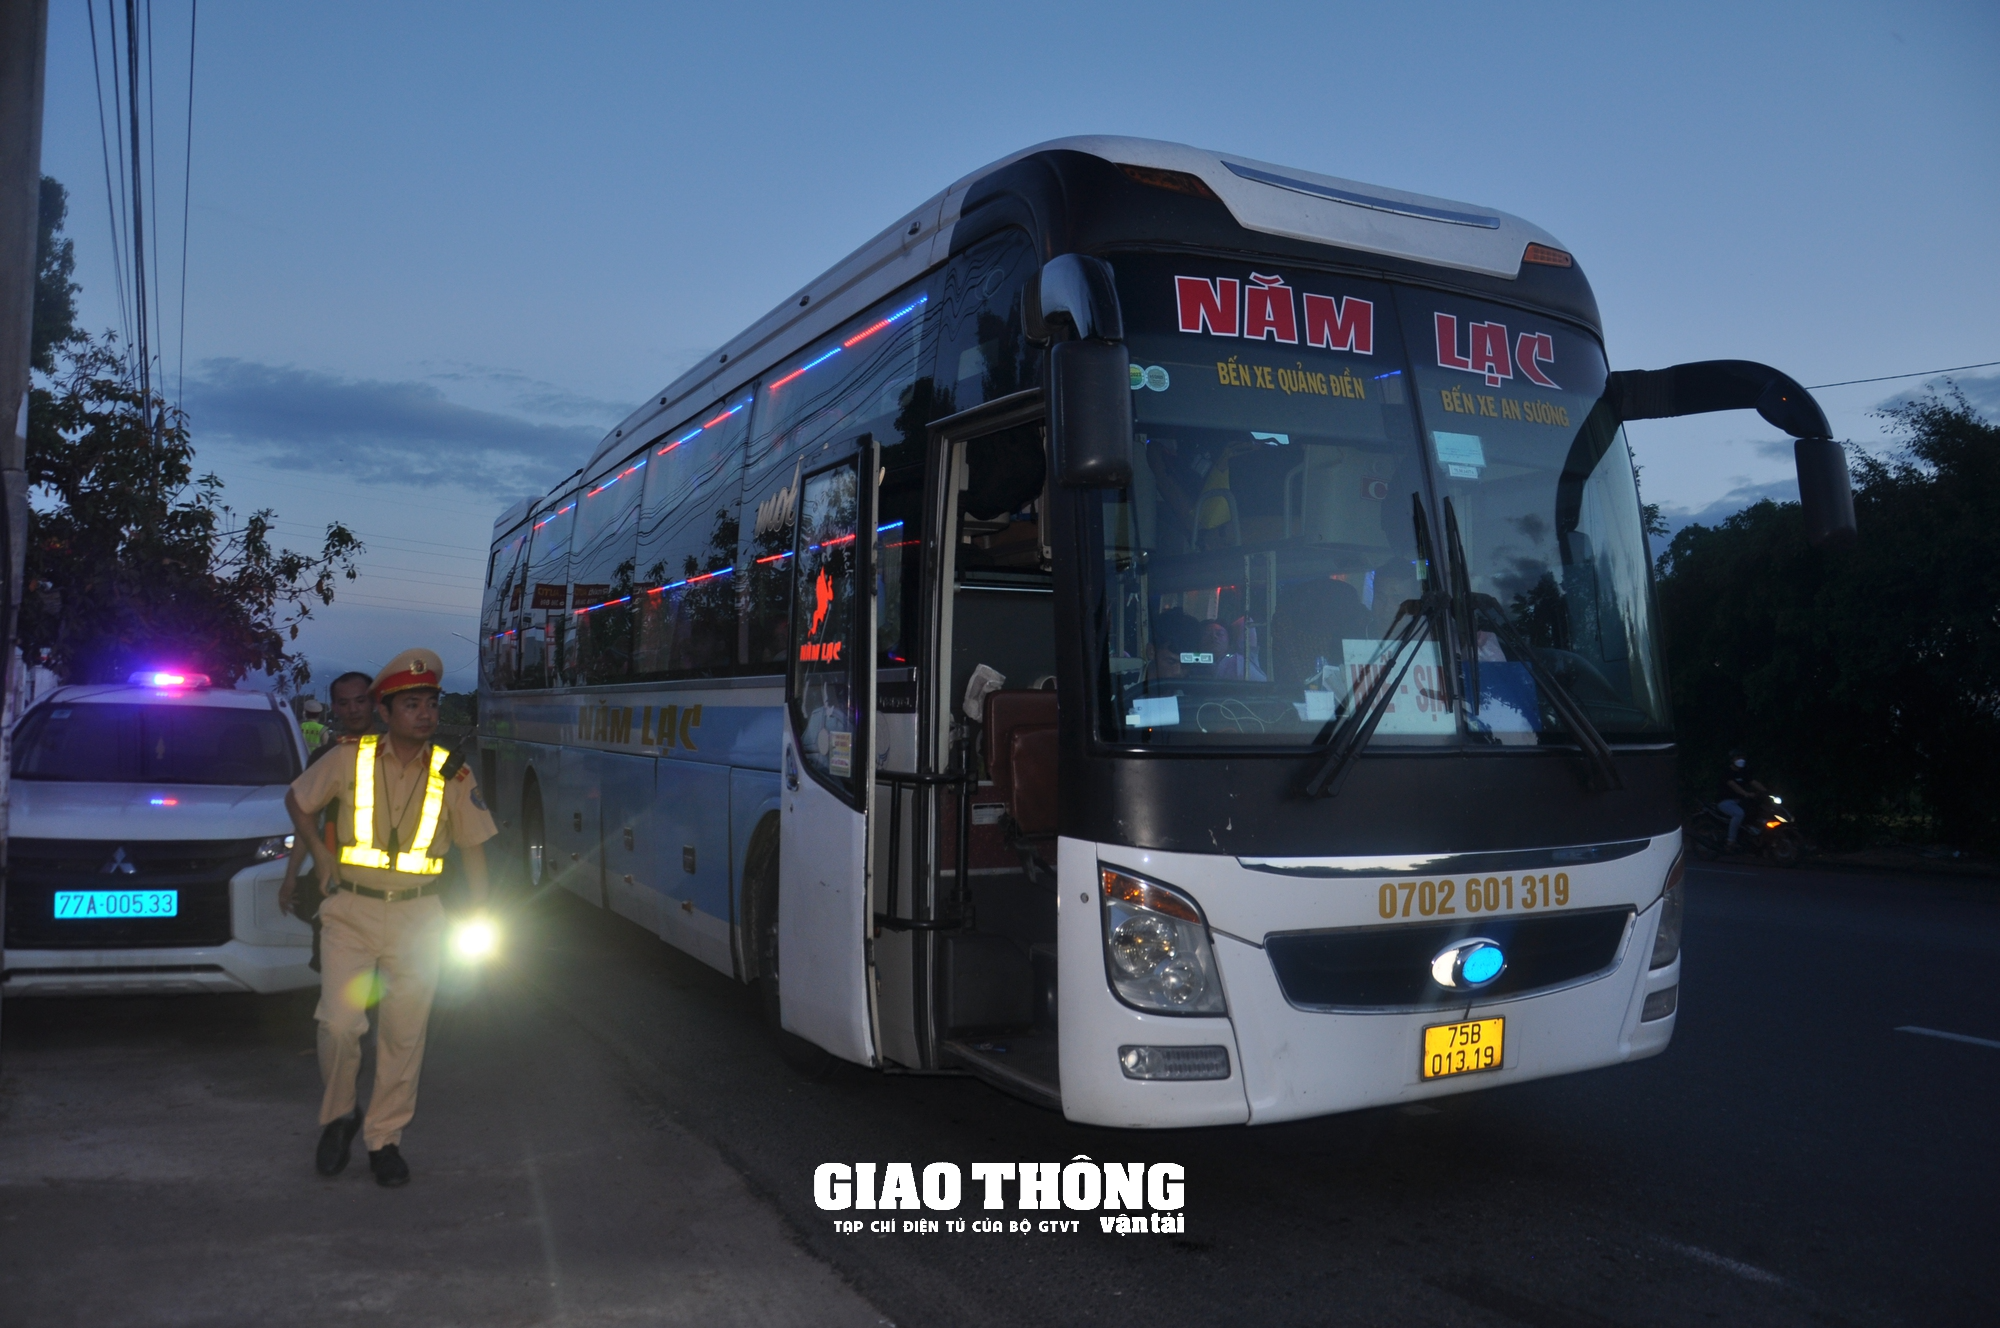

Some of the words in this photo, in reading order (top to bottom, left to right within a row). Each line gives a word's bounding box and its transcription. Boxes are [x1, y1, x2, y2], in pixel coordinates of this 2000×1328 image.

[1174, 271, 1374, 355] NĂM
[1433, 311, 1562, 390] LẠC
[1216, 355, 1252, 387] BẾN
[1252, 365, 1275, 390] XE
[1277, 361, 1328, 396] QUẢNG
[1329, 367, 1366, 400] ĐIỀN
[1441, 384, 1475, 415] BẾN
[1476, 394, 1498, 418] XE
[1501, 397, 1522, 421] AN
[1523, 399, 1570, 428] SƯƠNG
[821, 640, 843, 664] LẠC
[578, 699, 633, 744] NĂM
[641, 704, 703, 757] LẠC
[59, 893, 174, 915] 77A-005.33
[1378, 879, 1456, 919] 0702
[1465, 876, 1513, 913] 601
[1521, 872, 1569, 910] 319
[1447, 1023, 1482, 1048] 75B
[1431, 1045, 1495, 1076] 013.19
